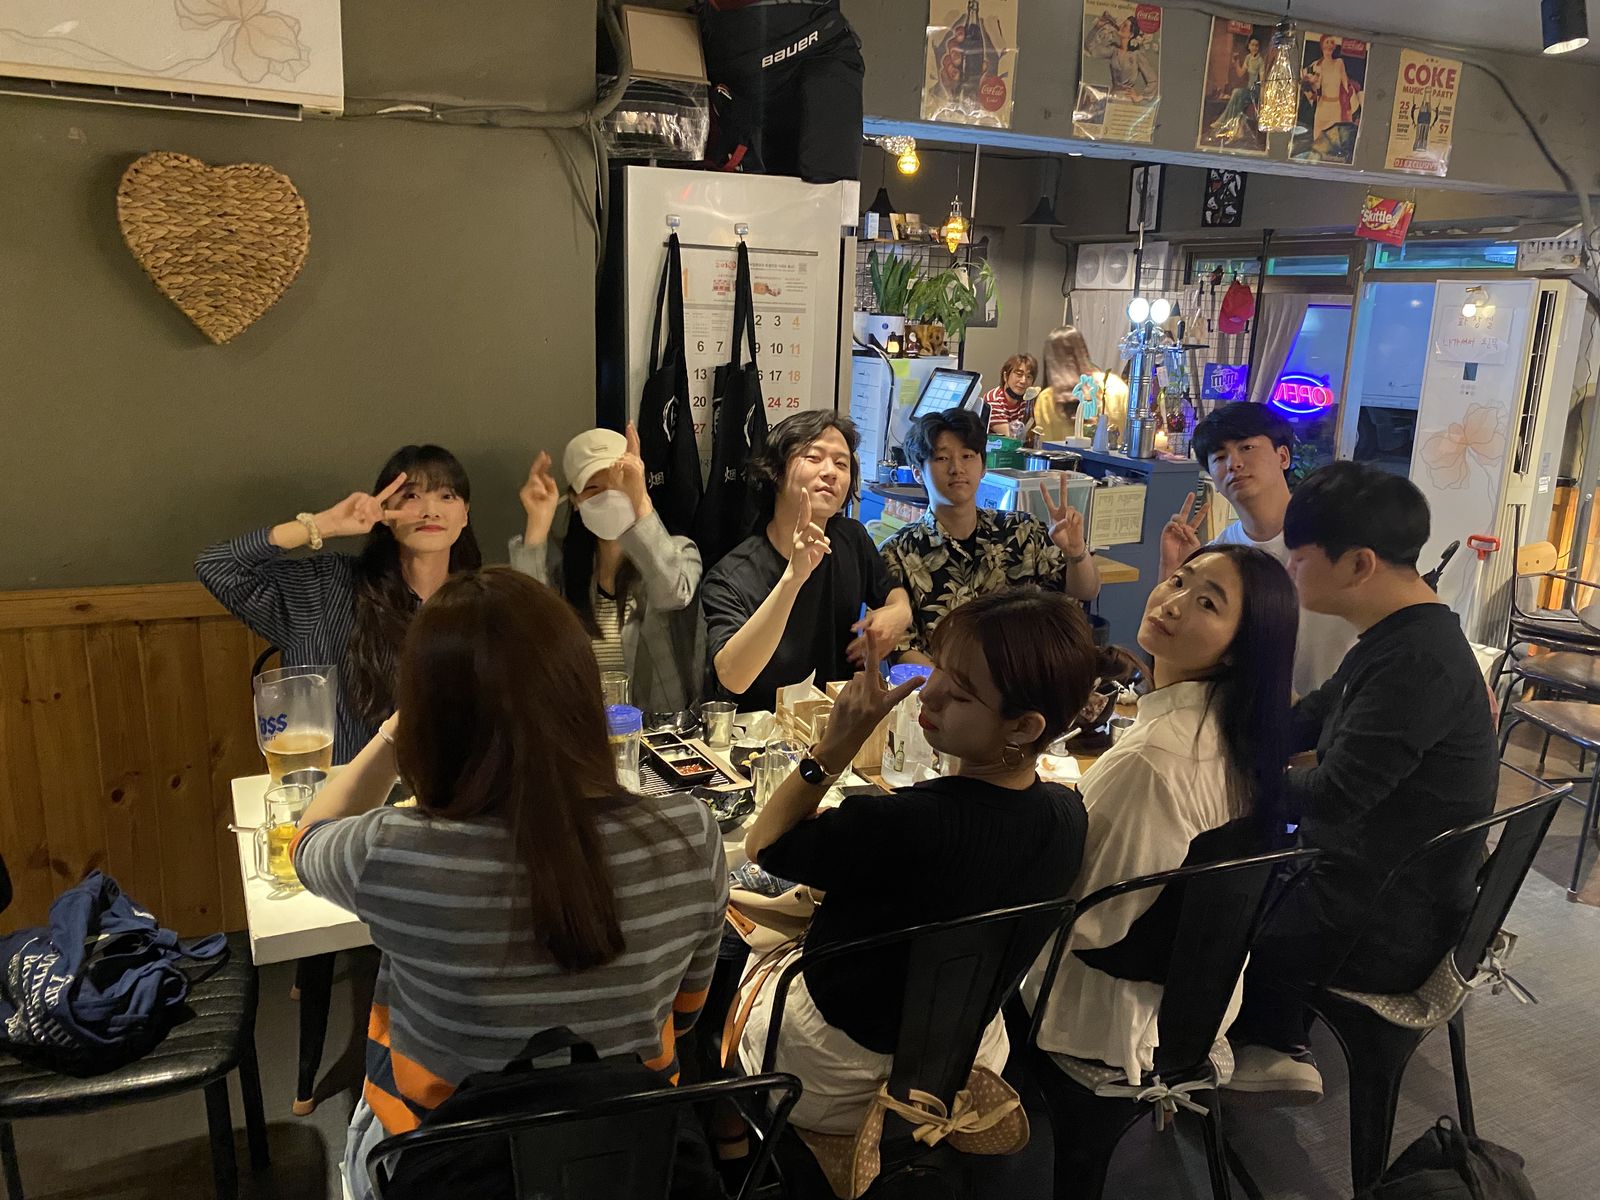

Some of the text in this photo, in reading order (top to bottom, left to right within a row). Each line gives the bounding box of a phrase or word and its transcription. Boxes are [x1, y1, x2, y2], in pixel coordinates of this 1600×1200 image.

[761, 30, 819, 68] BAUER
[1403, 63, 1457, 90] COKE
[1402, 86, 1454, 100] MUSIC PARTY
[1399, 101, 1410, 110] 25
[755, 314, 800, 327] 2 3 4
[697, 341, 705, 352] 6
[716, 341, 724, 352] 7
[770, 343, 784, 354] 10
[790, 343, 800, 354] 11
[694, 368, 707, 380] 13
[769, 370, 782, 381] 17
[788, 370, 801, 382] 18
[693, 396, 799, 408] 20 24 25
[693, 423, 706, 434] 27
[259, 713, 288, 735] ass
